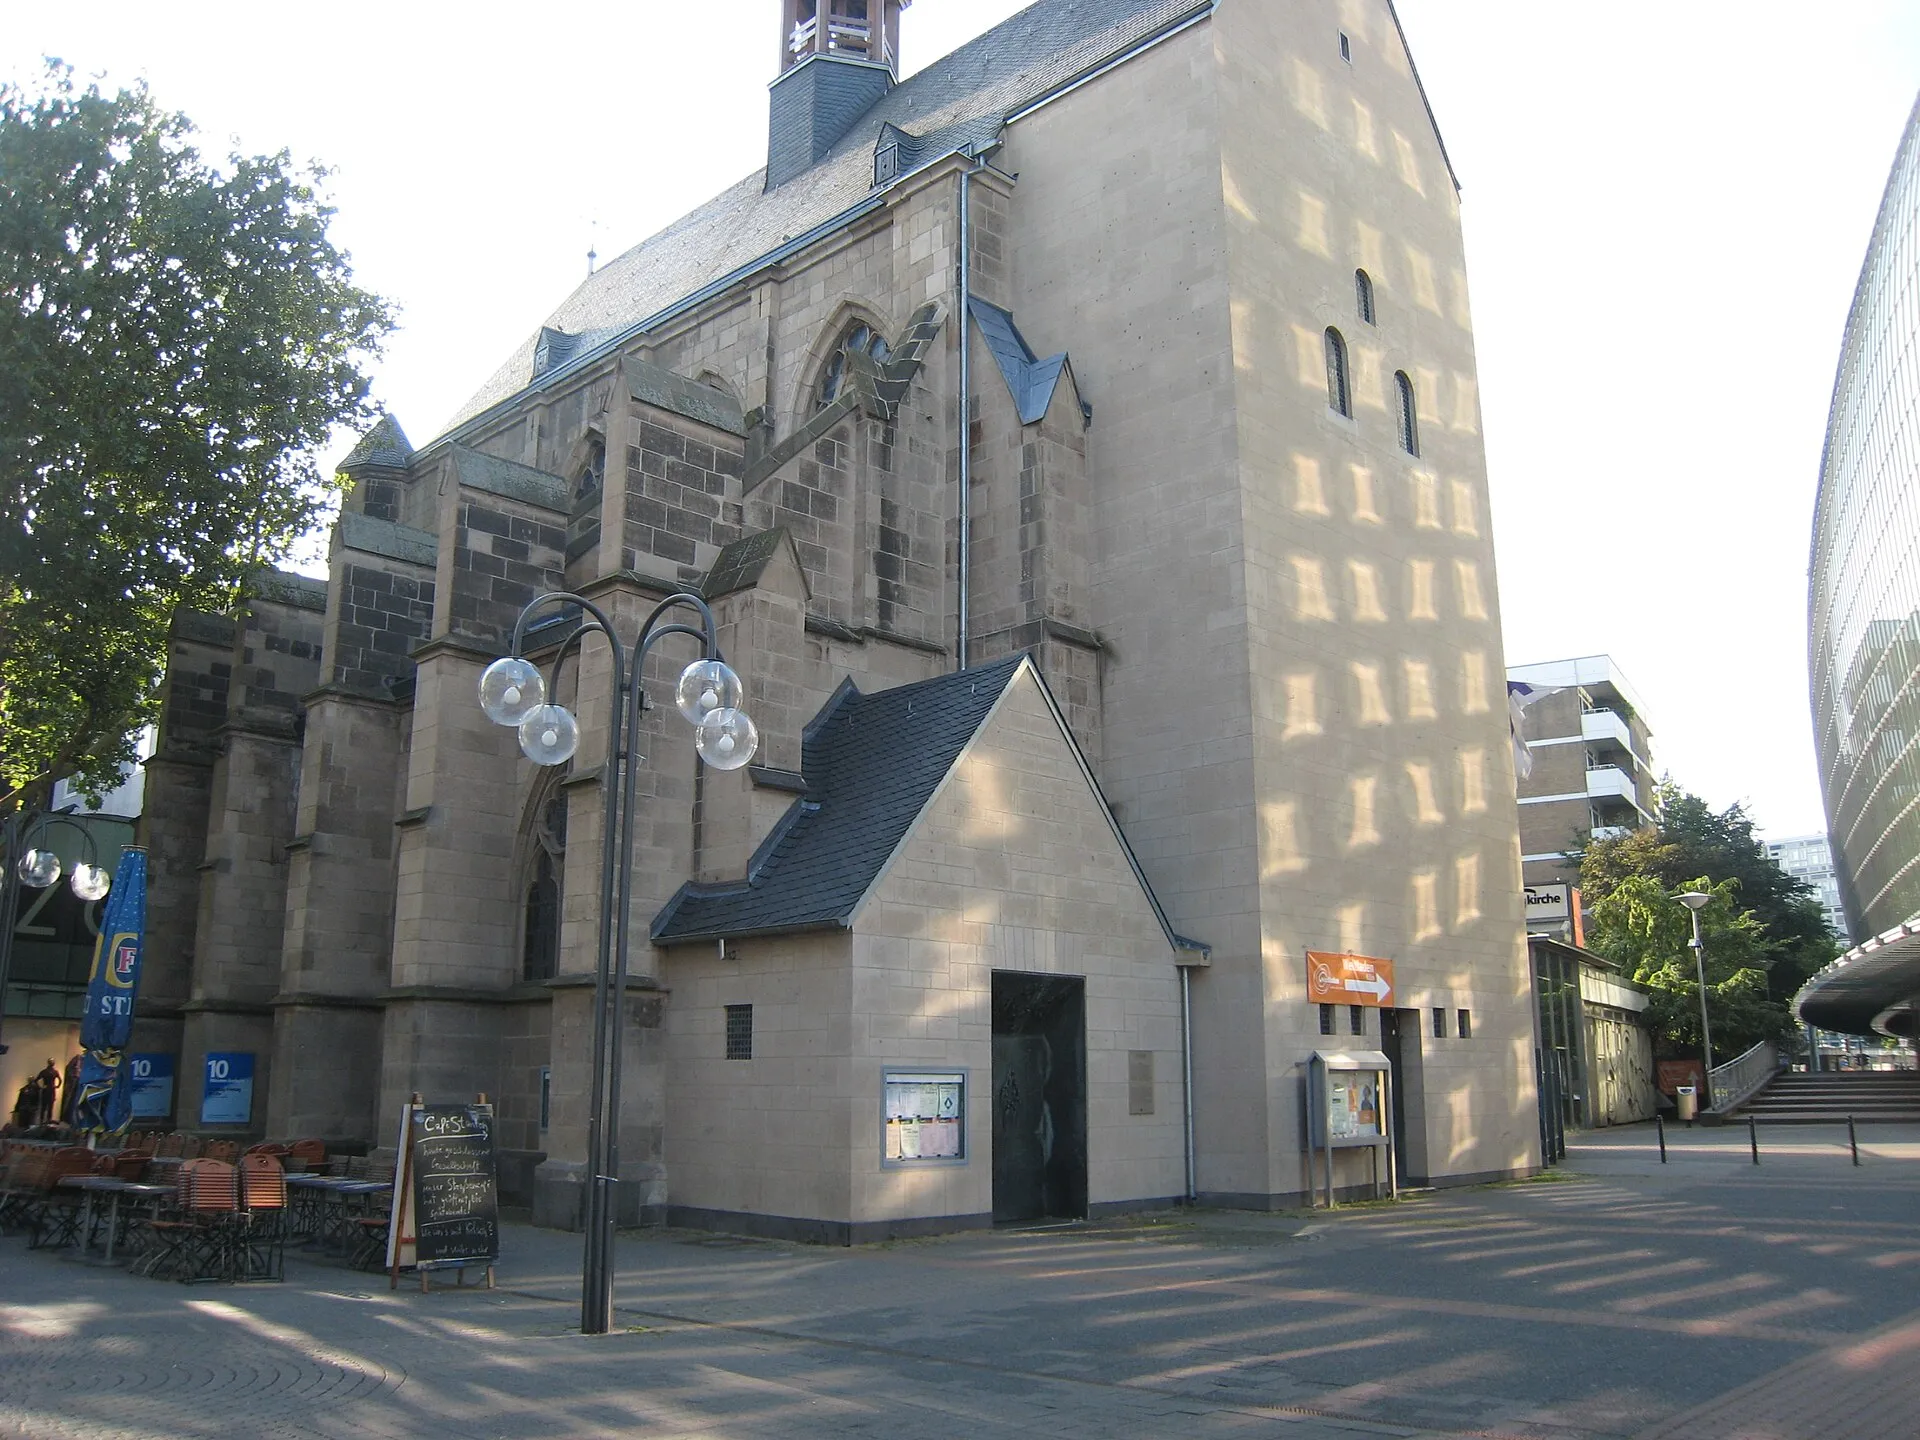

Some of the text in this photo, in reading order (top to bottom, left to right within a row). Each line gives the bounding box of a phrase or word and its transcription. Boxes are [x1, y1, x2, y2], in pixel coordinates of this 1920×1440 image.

[1525, 893, 1561, 906] kirche
[116, 946, 137, 973] F
[131, 1059, 151, 1076] 10
[207, 1060, 229, 1078] 10
